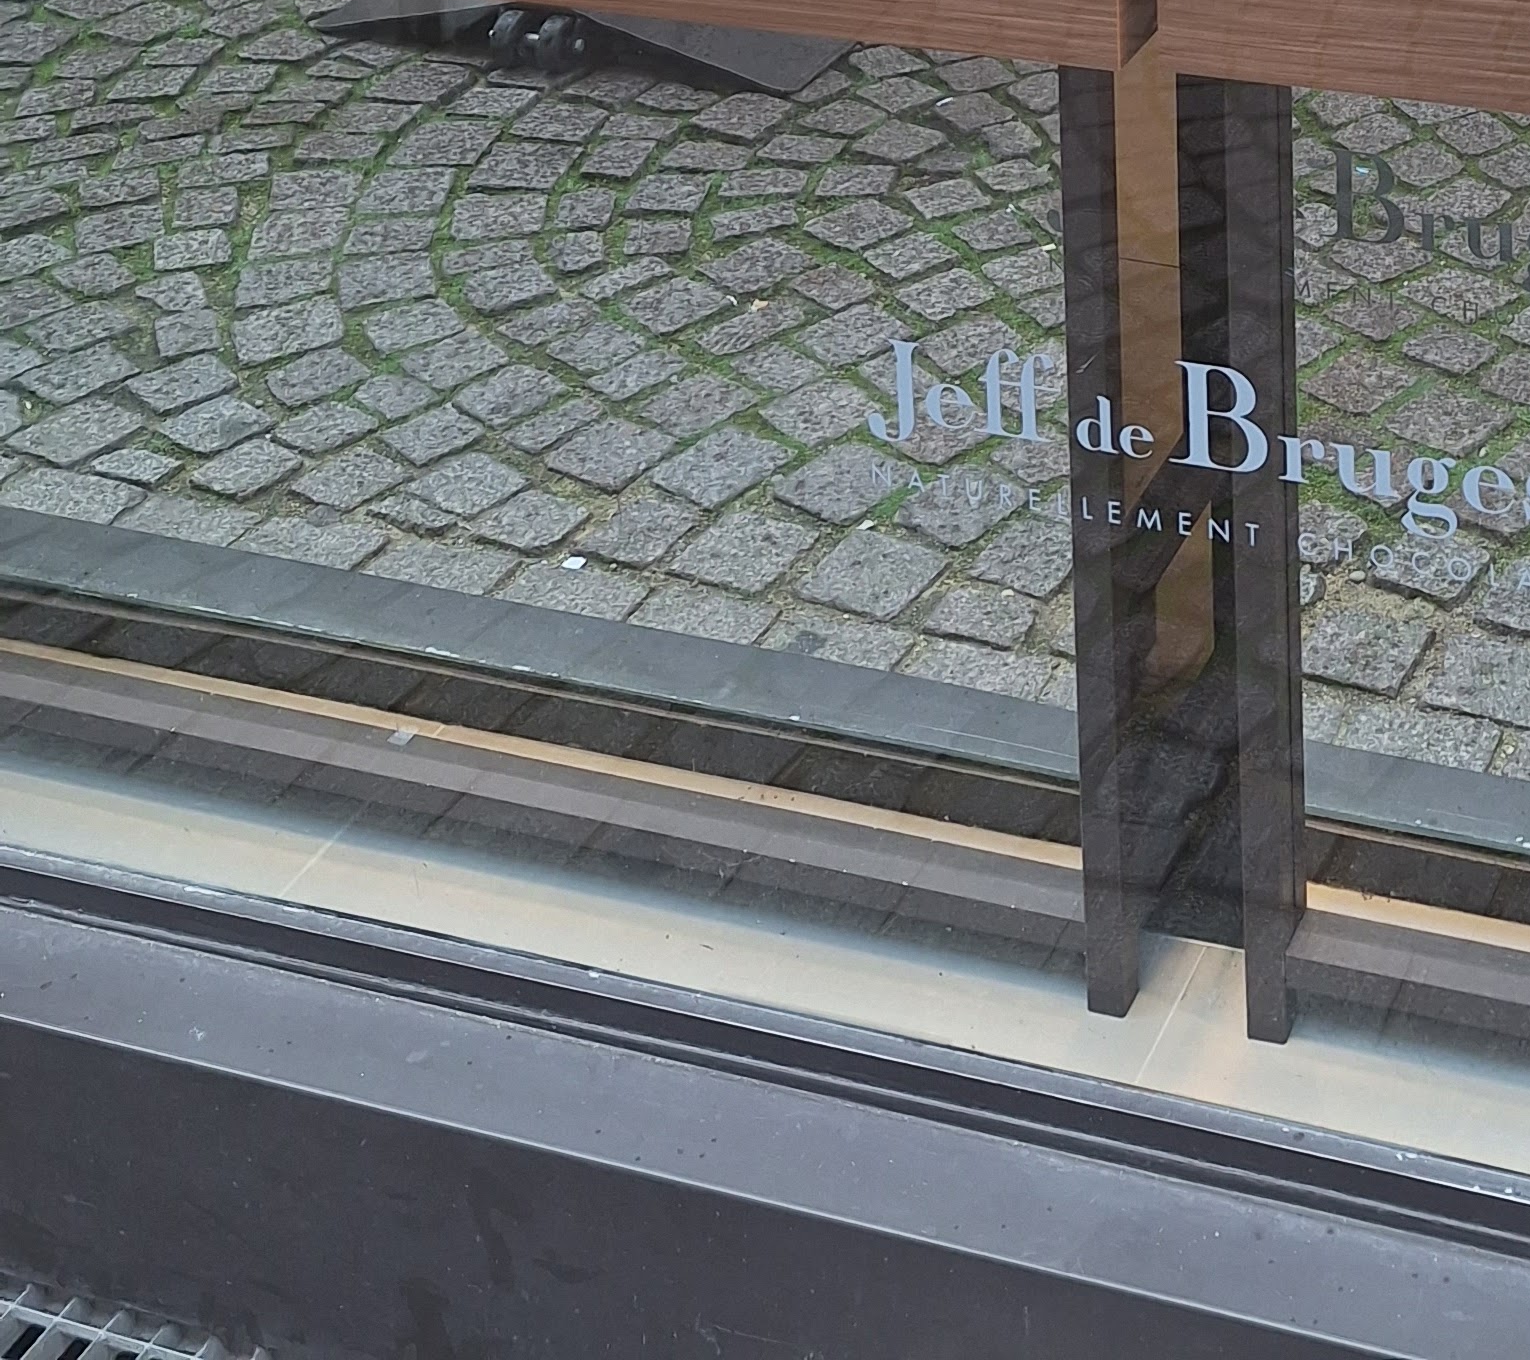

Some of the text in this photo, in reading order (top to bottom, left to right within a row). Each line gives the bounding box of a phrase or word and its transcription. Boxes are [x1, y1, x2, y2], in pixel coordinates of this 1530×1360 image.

[866, 336, 1063, 444] Jeff
[1075, 394, 1156, 460] de
[871, 462, 1260, 548] NATURELLEMENT
